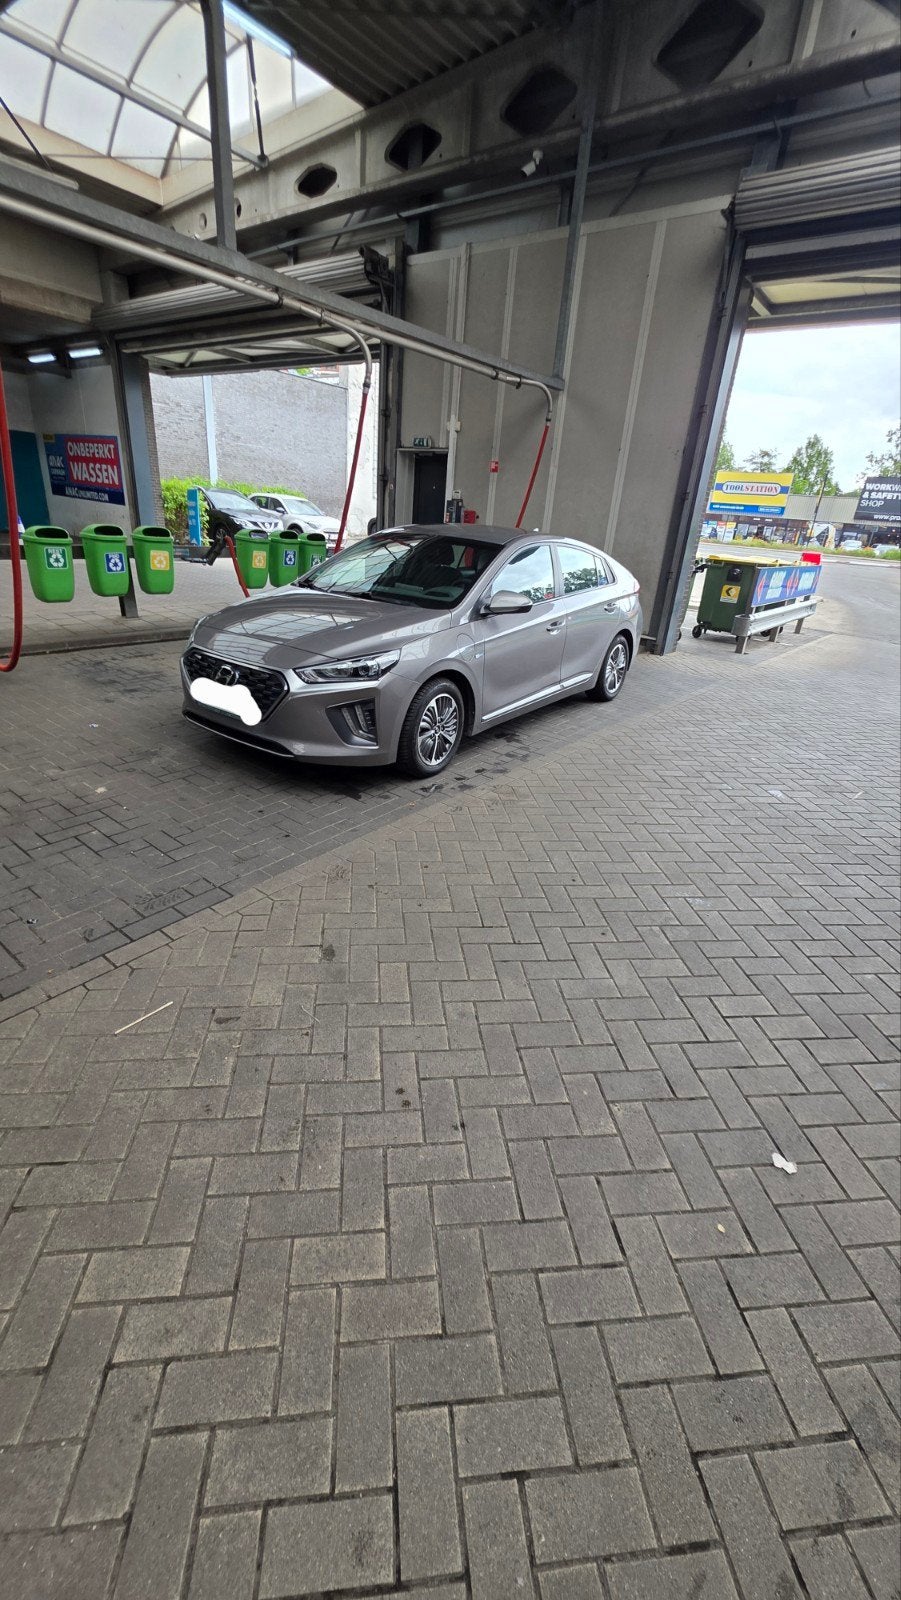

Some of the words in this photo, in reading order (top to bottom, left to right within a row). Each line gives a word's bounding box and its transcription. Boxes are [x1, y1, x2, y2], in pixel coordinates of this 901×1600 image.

[67, 442, 114, 458] ONBEPERKT
[69, 461, 119, 485] WASSEN
[725, 484, 779, 494] TOOLSTATION
[860, 499, 884, 507] SHOP
